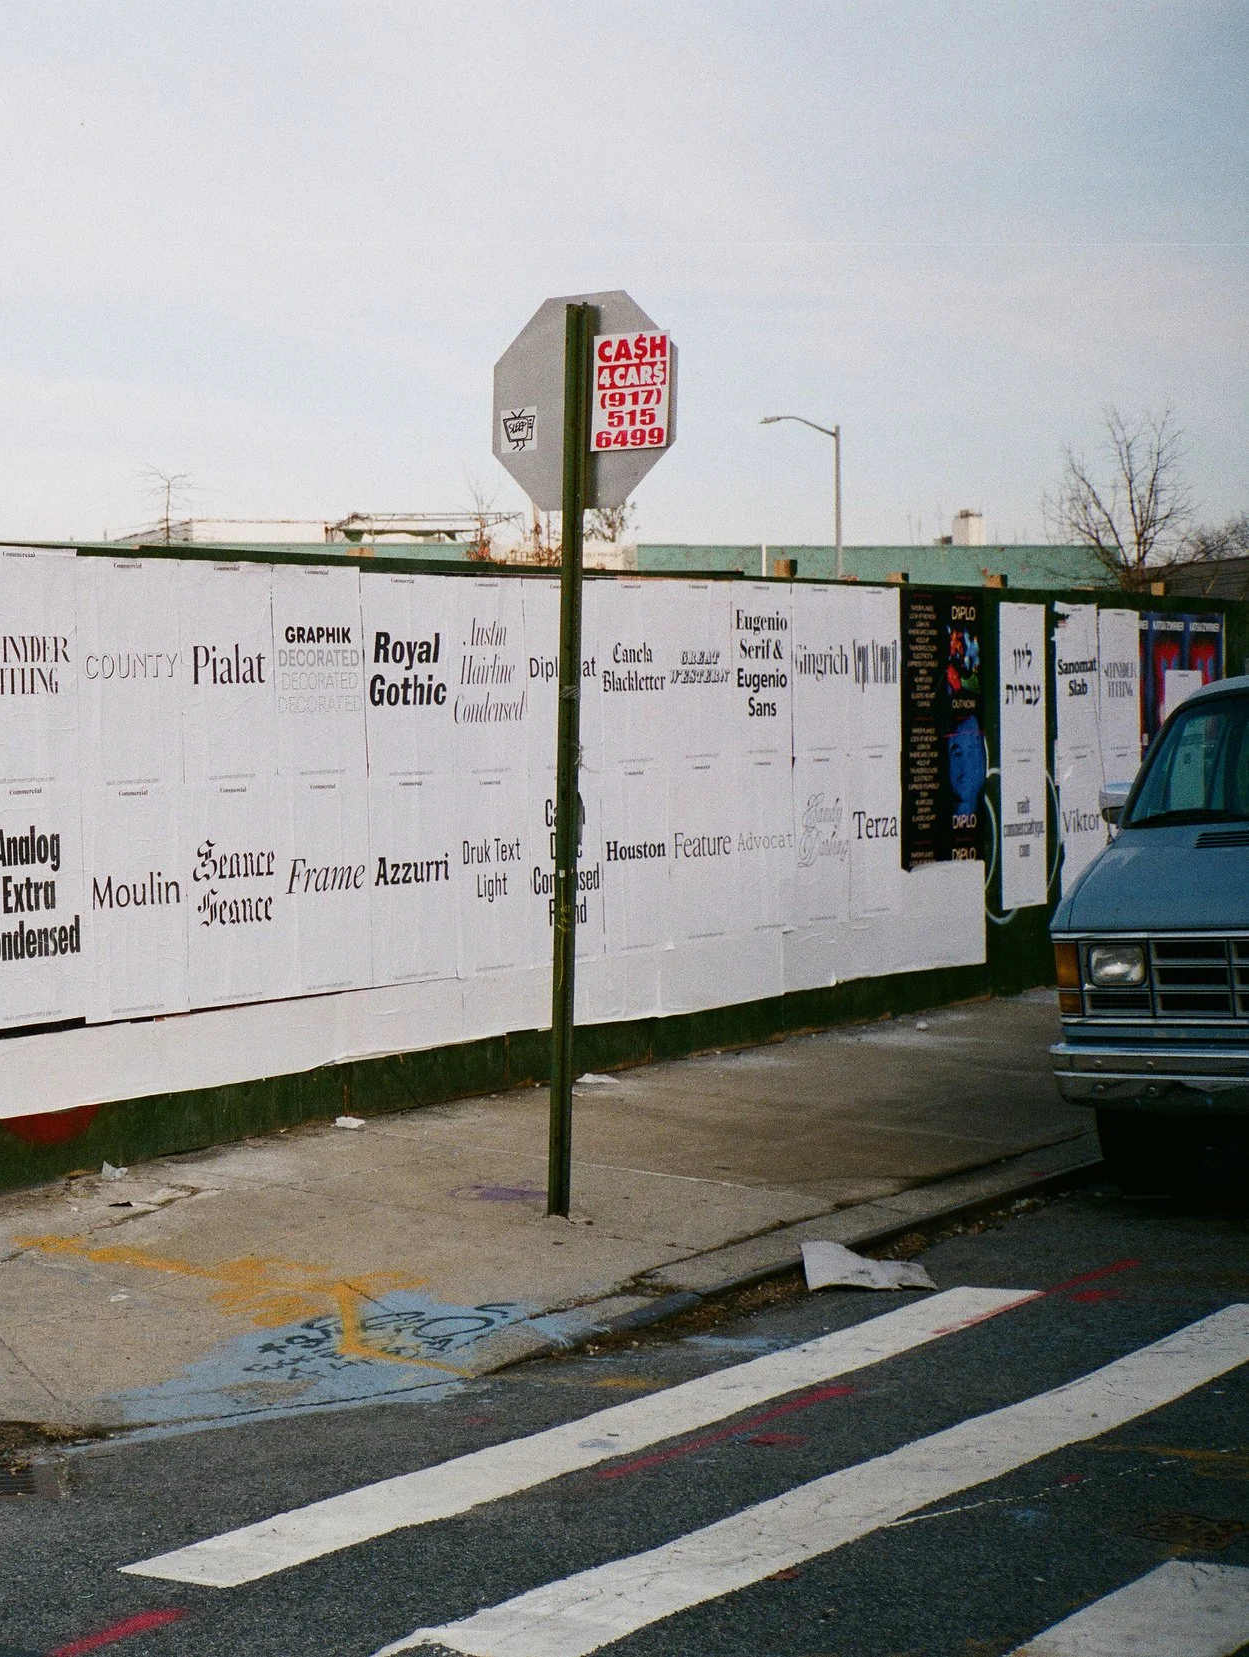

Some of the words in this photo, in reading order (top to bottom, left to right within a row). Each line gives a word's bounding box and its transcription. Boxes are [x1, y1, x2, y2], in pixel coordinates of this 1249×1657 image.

[600, 389, 662, 409] (917)
[508, 421, 527, 434] SLEEP
[608, 408, 656, 428] 515
[596, 427, 664, 449] 6499
[736, 609, 787, 635] Eugenio
[951, 605, 976, 621] DIPLO
[285, 626, 351, 644] GRAPHIK
[278, 649, 359, 668] DECORATED
[374, 631, 440, 670] Royal
[739, 639, 770, 660] Serif
[773, 640, 784, 660] &
[86, 652, 178, 679] COUNTY
[193, 643, 266, 685] Pialat
[460, 655, 515, 685] Hairline
[530, 656, 596, 682] Diplat
[795, 644, 848, 681] Gingrich
[1058, 657, 1097, 676] Sanomat
[282, 672, 357, 690] DECORATED
[370, 674, 447, 706] Gothic
[603, 670, 666, 693] Blackletter
[737, 667, 787, 693] Eugenio
[1069, 678, 1088, 697] Slab
[278, 696, 363, 714] DECORATED
[454, 691, 525, 724] Condensed
[748, 697, 776, 717] Sans
[1005, 684, 1040, 706] עברית
[852, 811, 898, 839] Terza
[952, 814, 977, 829] DIPLO
[1062, 808, 1100, 833] Viktor
[462, 840, 491, 865] Druk
[494, 838, 521, 862] Text
[606, 840, 666, 862] Houston
[674, 831, 731, 859] Feature
[952, 847, 976, 860] DIPLO
[285, 858, 365, 895] Frame
[375, 853, 449, 887] Azzurri
[533, 862, 599, 894] Consed
[2, 876, 56, 914] Extra
[93, 871, 181, 910] Moulin
[477, 874, 508, 903] Light
